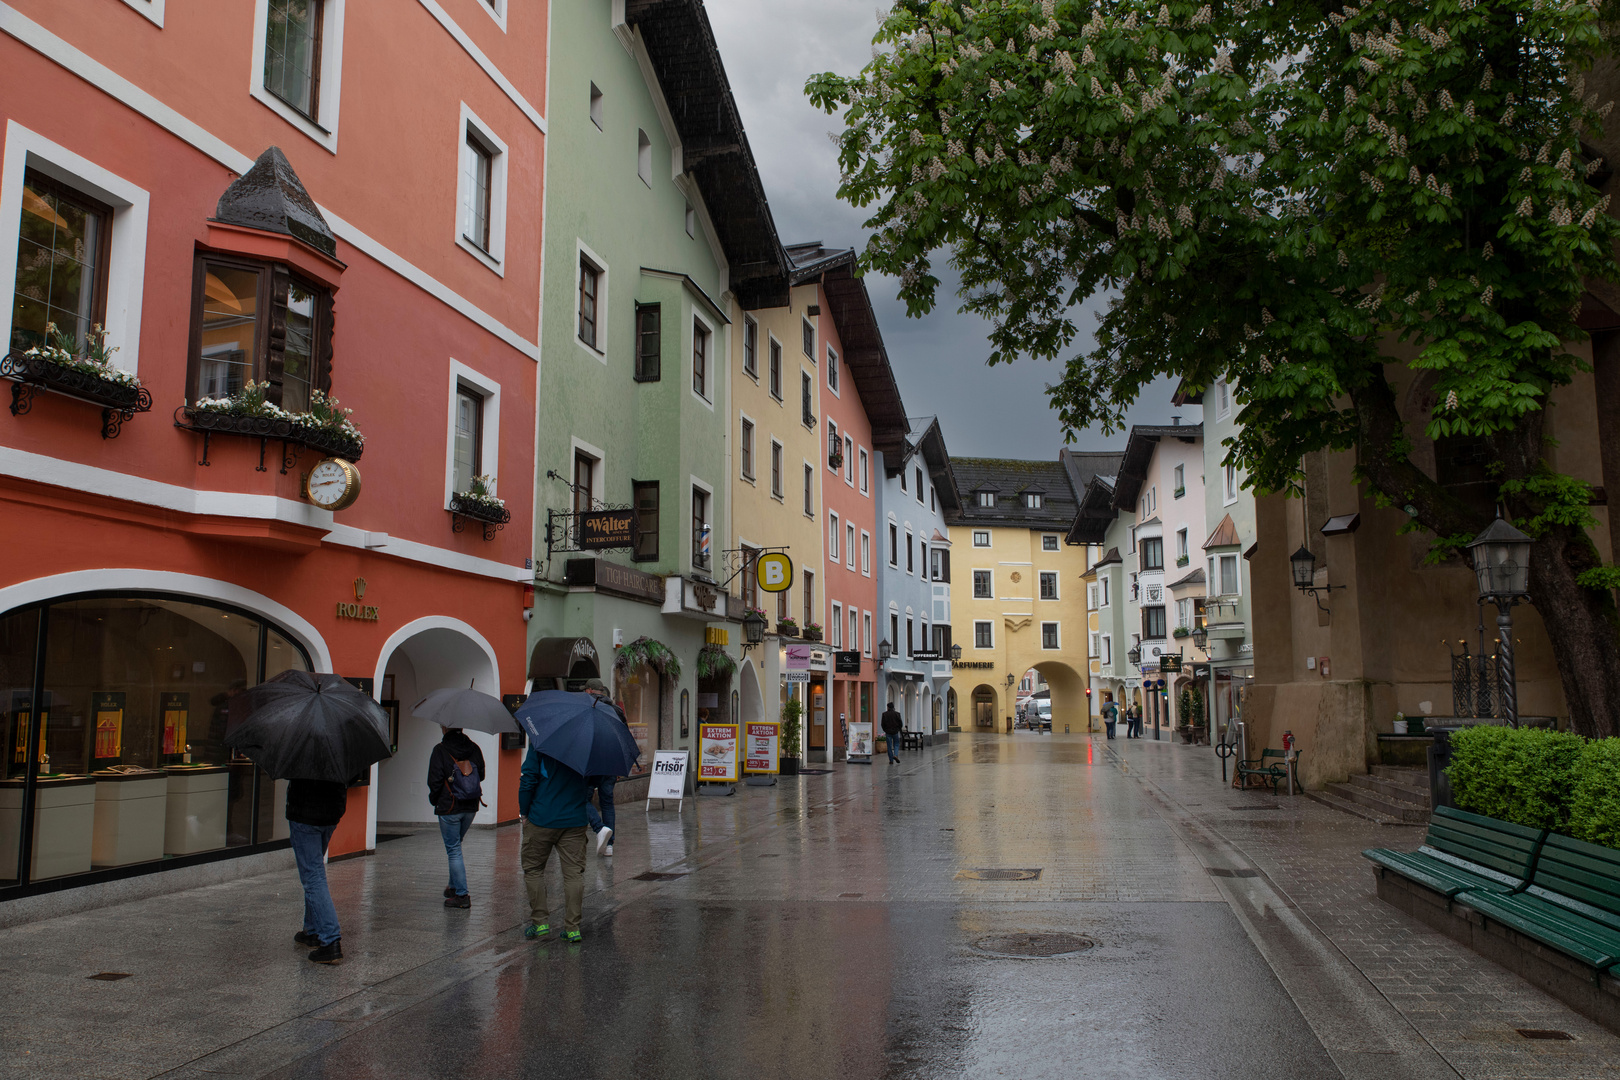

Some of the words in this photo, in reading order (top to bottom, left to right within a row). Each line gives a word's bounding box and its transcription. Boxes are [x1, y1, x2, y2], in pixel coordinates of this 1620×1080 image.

[586, 516, 632, 534] Walter
[604, 566, 621, 584] TIGI
[623, 572, 658, 594] HAIRCARE
[765, 561, 784, 584] B
[336, 602, 380, 620] ROLEX
[574, 640, 596, 658] Walter
[655, 760, 684, 772] Frisör
